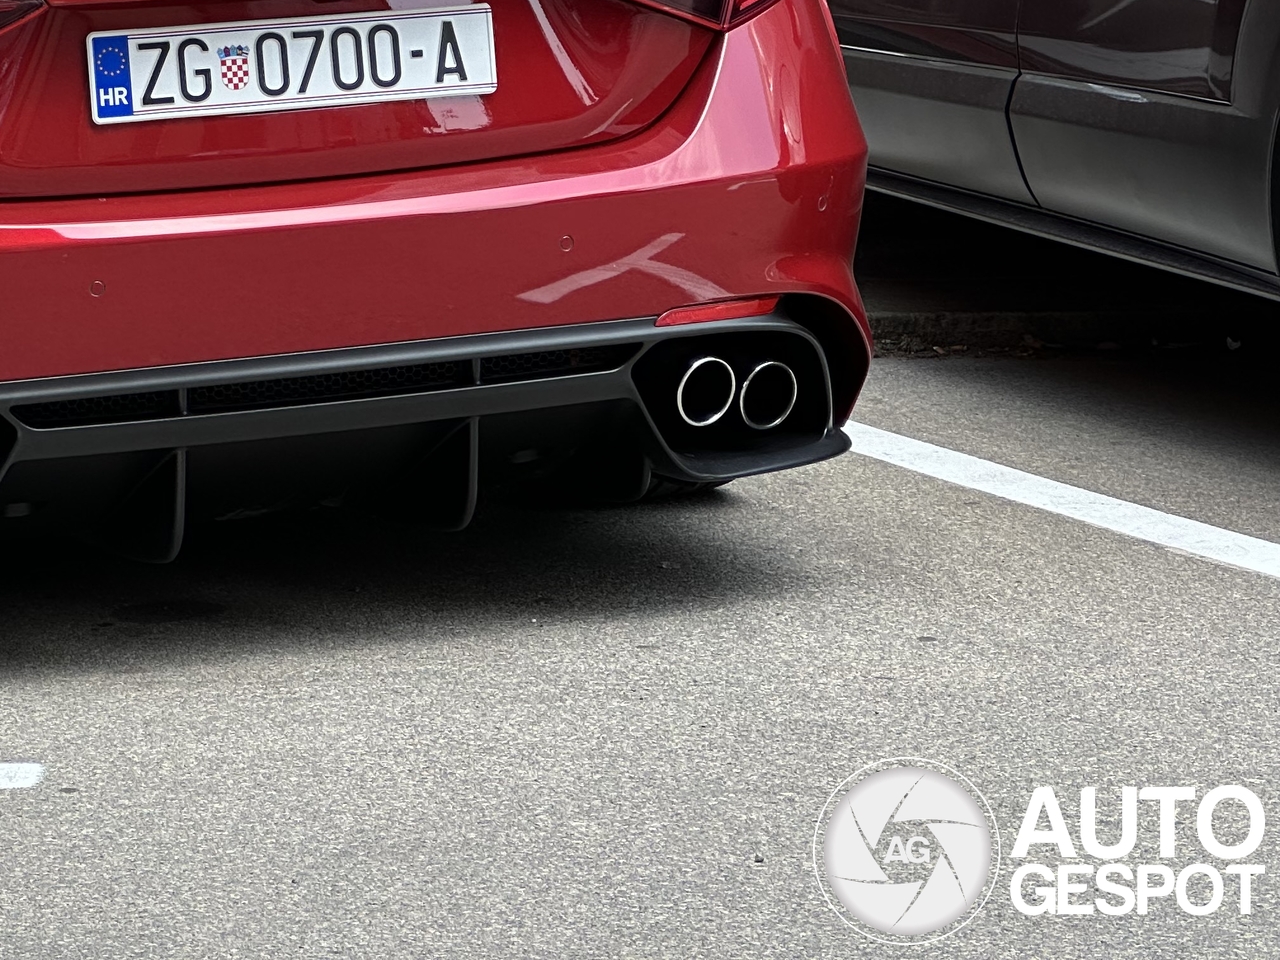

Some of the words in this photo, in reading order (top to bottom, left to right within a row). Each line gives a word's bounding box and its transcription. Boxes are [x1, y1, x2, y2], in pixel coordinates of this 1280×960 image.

[137, 37, 213, 106] ZG
[255, 20, 469, 96] 0700-A
[99, 87, 129, 107] HR
